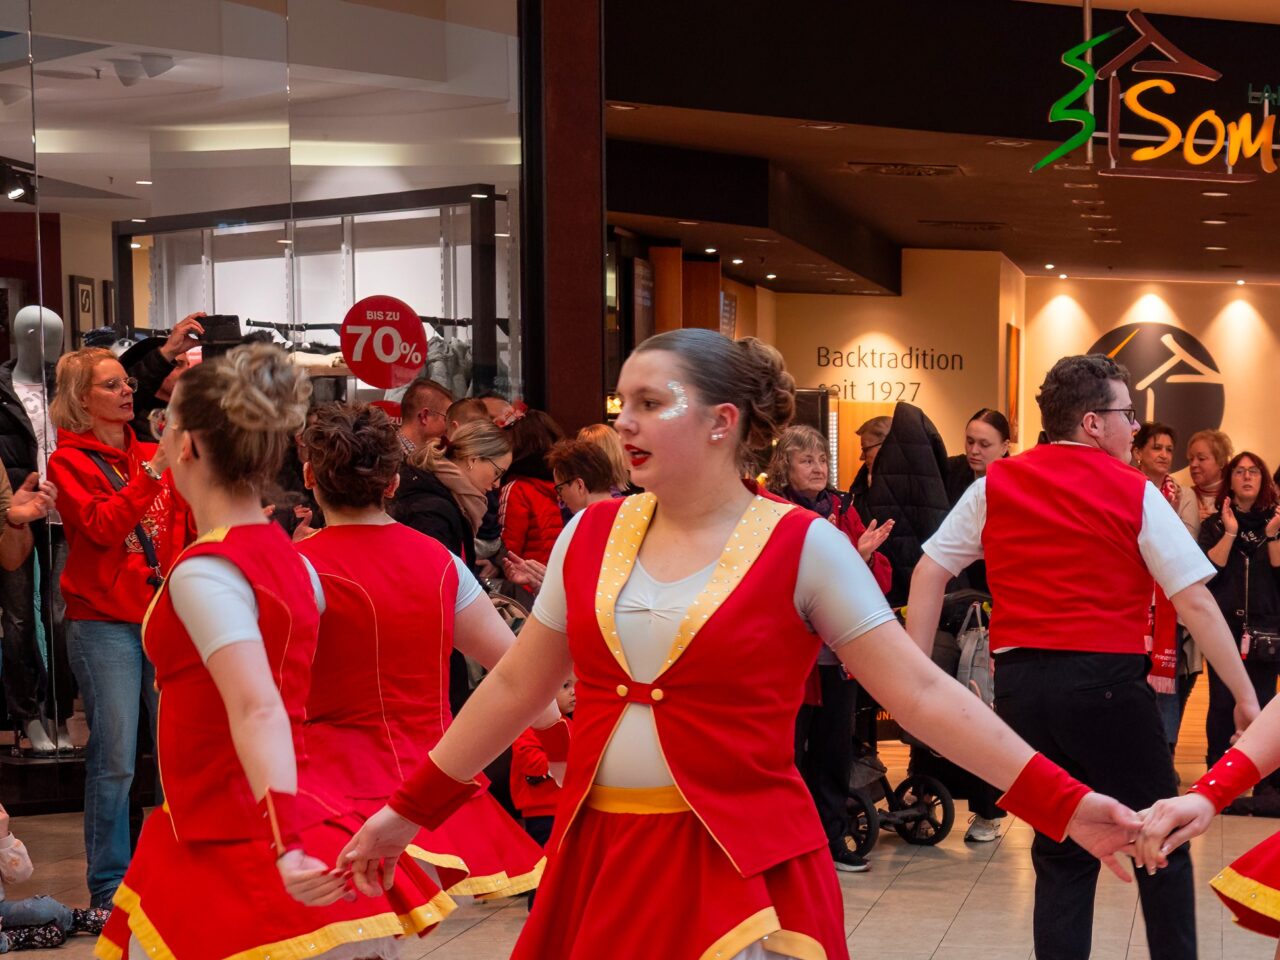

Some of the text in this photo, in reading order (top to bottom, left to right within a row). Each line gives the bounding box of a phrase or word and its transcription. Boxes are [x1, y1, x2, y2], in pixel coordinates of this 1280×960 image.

[366, 311, 400, 320] BIS ZU
[346, 325, 421, 364] 70%
[817, 345, 963, 370] Backtradition
[867, 381, 921, 401] 1927
